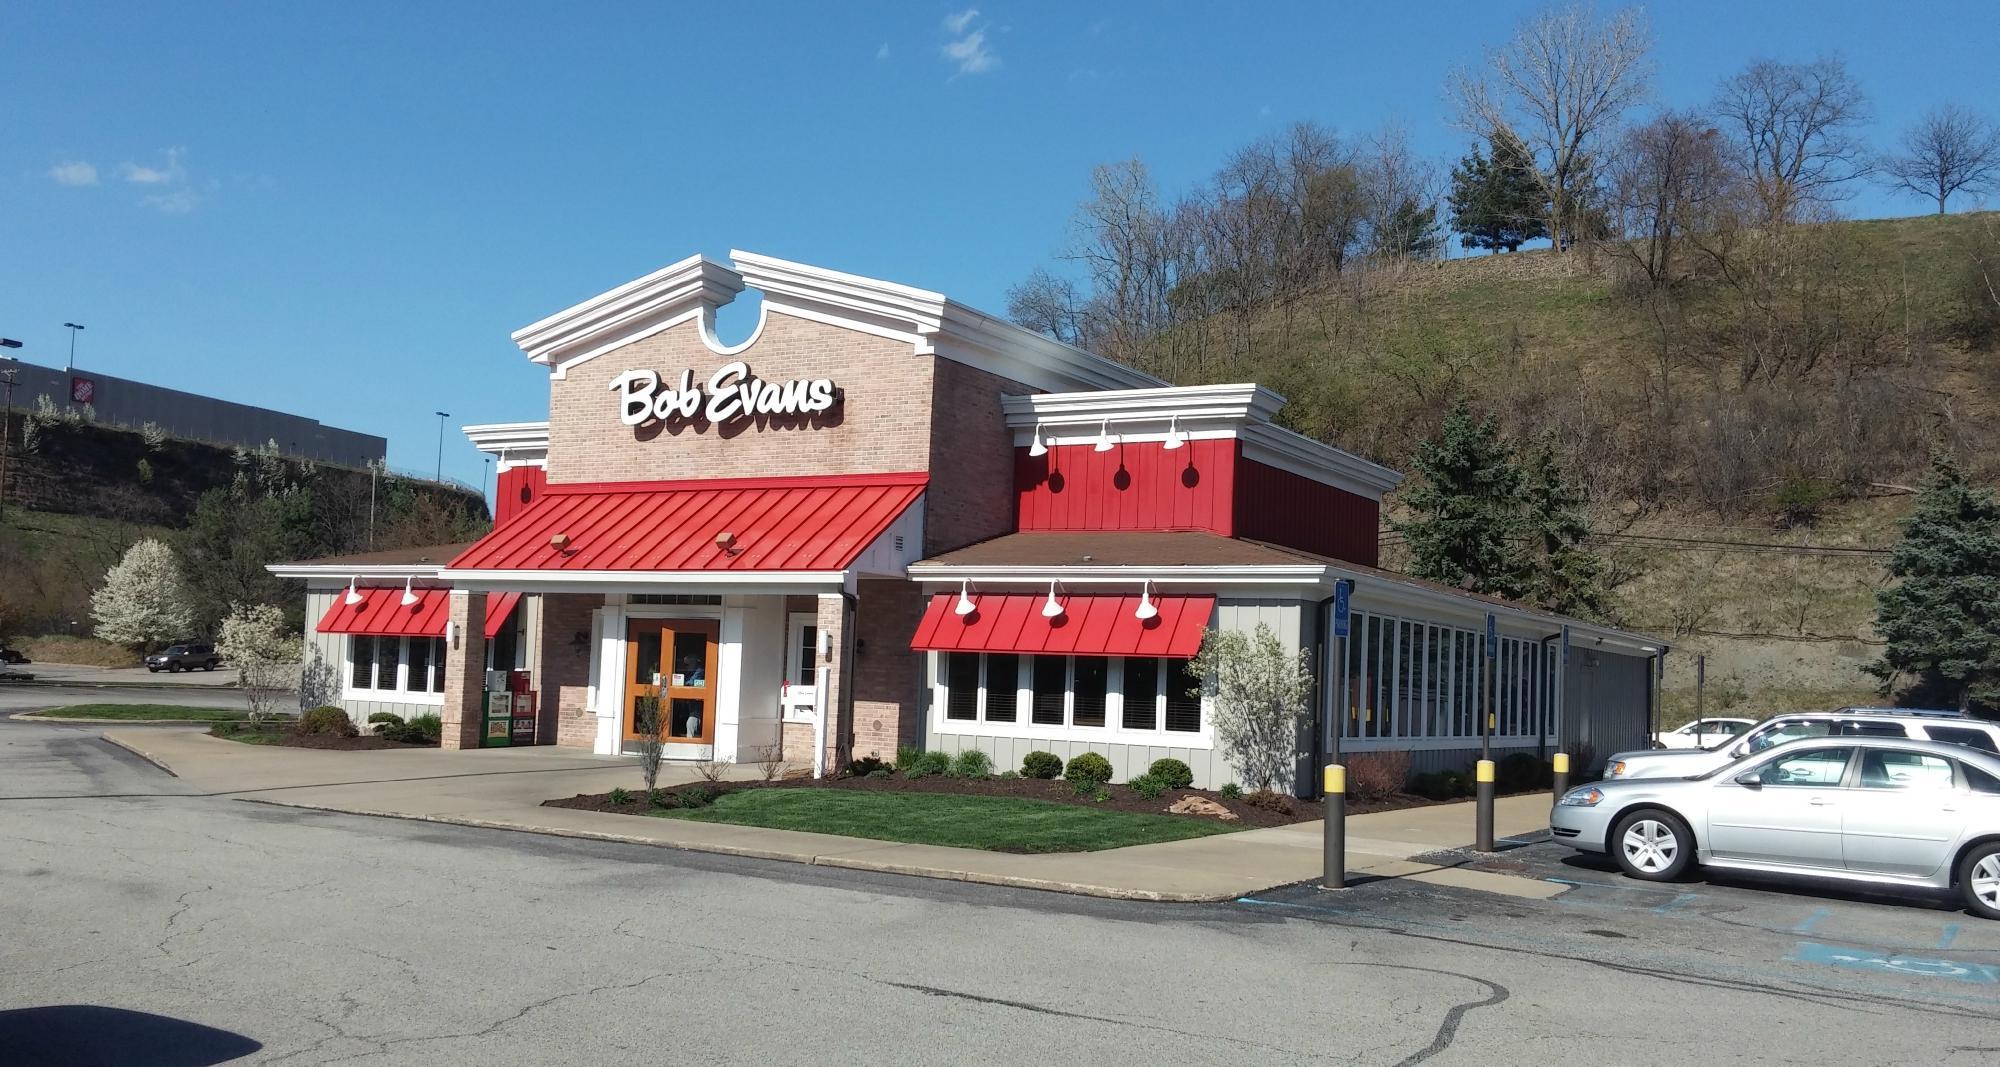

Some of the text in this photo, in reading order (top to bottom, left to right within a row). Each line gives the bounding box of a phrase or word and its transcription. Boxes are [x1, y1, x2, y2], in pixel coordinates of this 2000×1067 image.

[74, 382, 95, 400] HOME
[608, 361, 833, 426] Bob Evans
